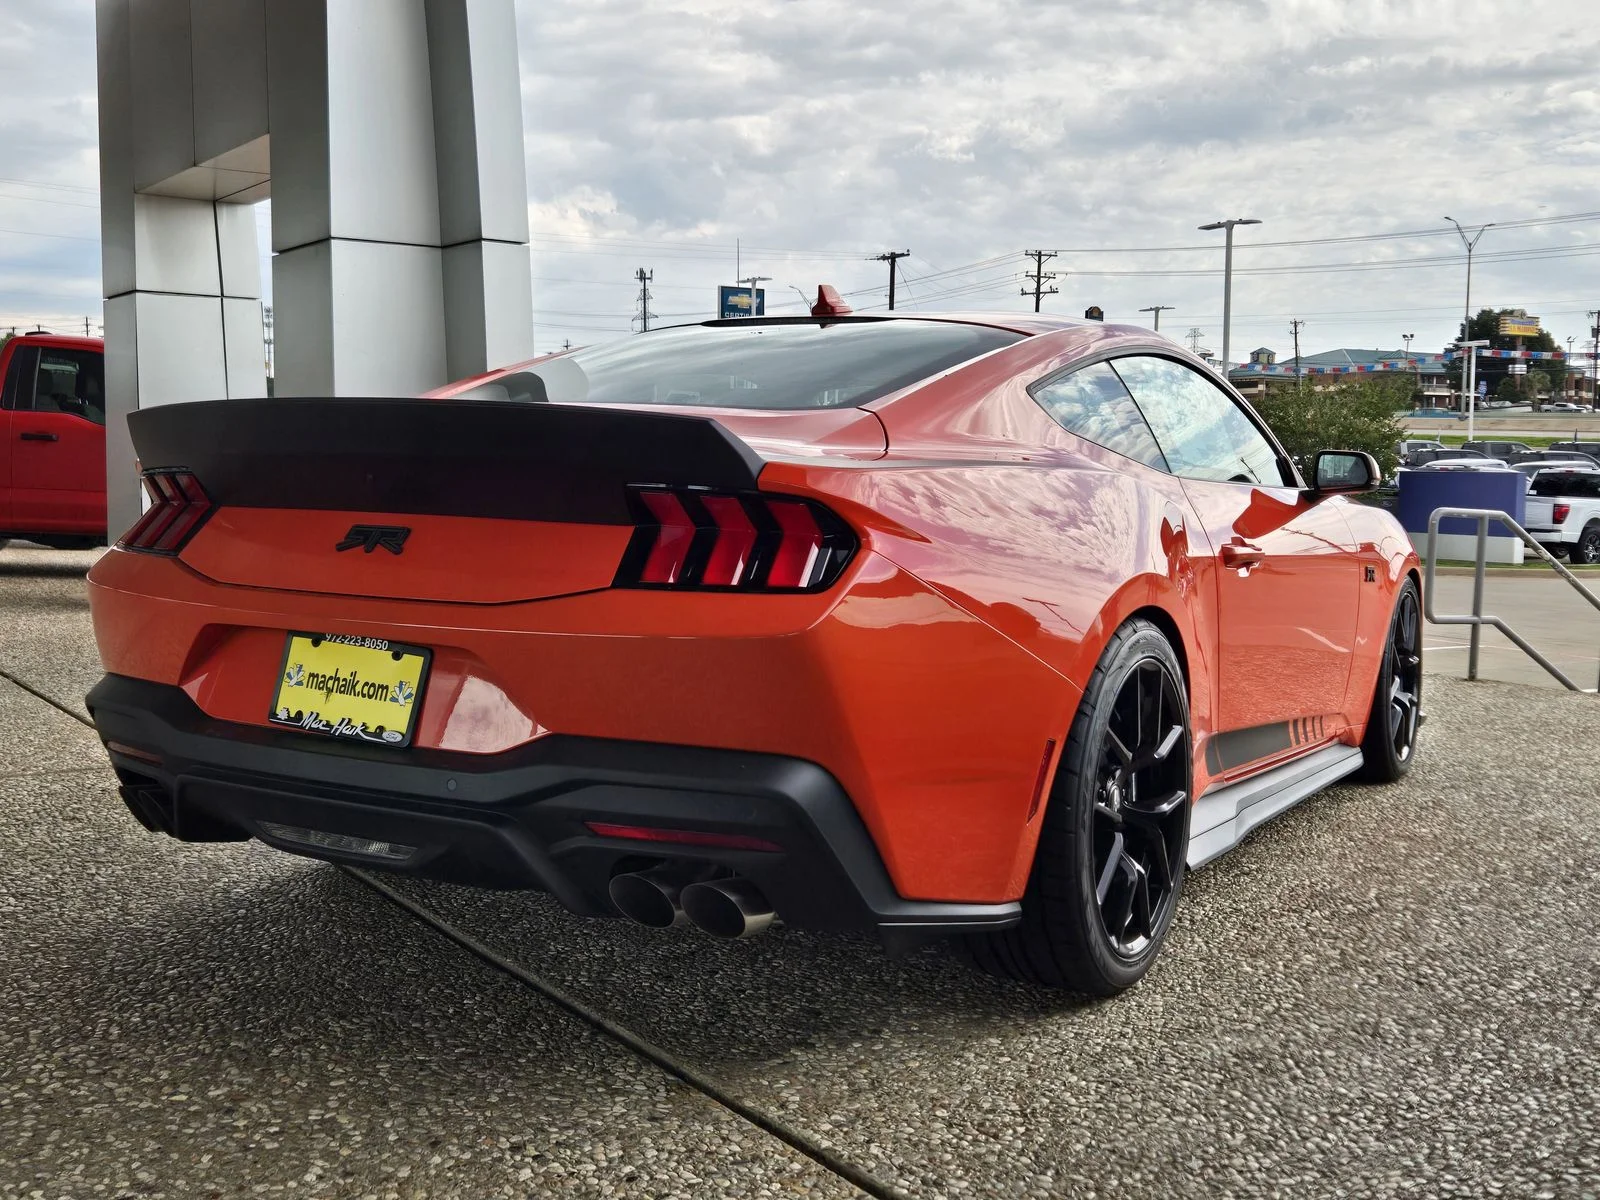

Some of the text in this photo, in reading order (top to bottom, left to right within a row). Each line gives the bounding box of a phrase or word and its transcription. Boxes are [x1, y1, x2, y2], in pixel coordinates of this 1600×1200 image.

[325, 633, 389, 650] 972-223-8050
[305, 668, 389, 702] machaik.com
[300, 712, 367, 736] Mac Haik
